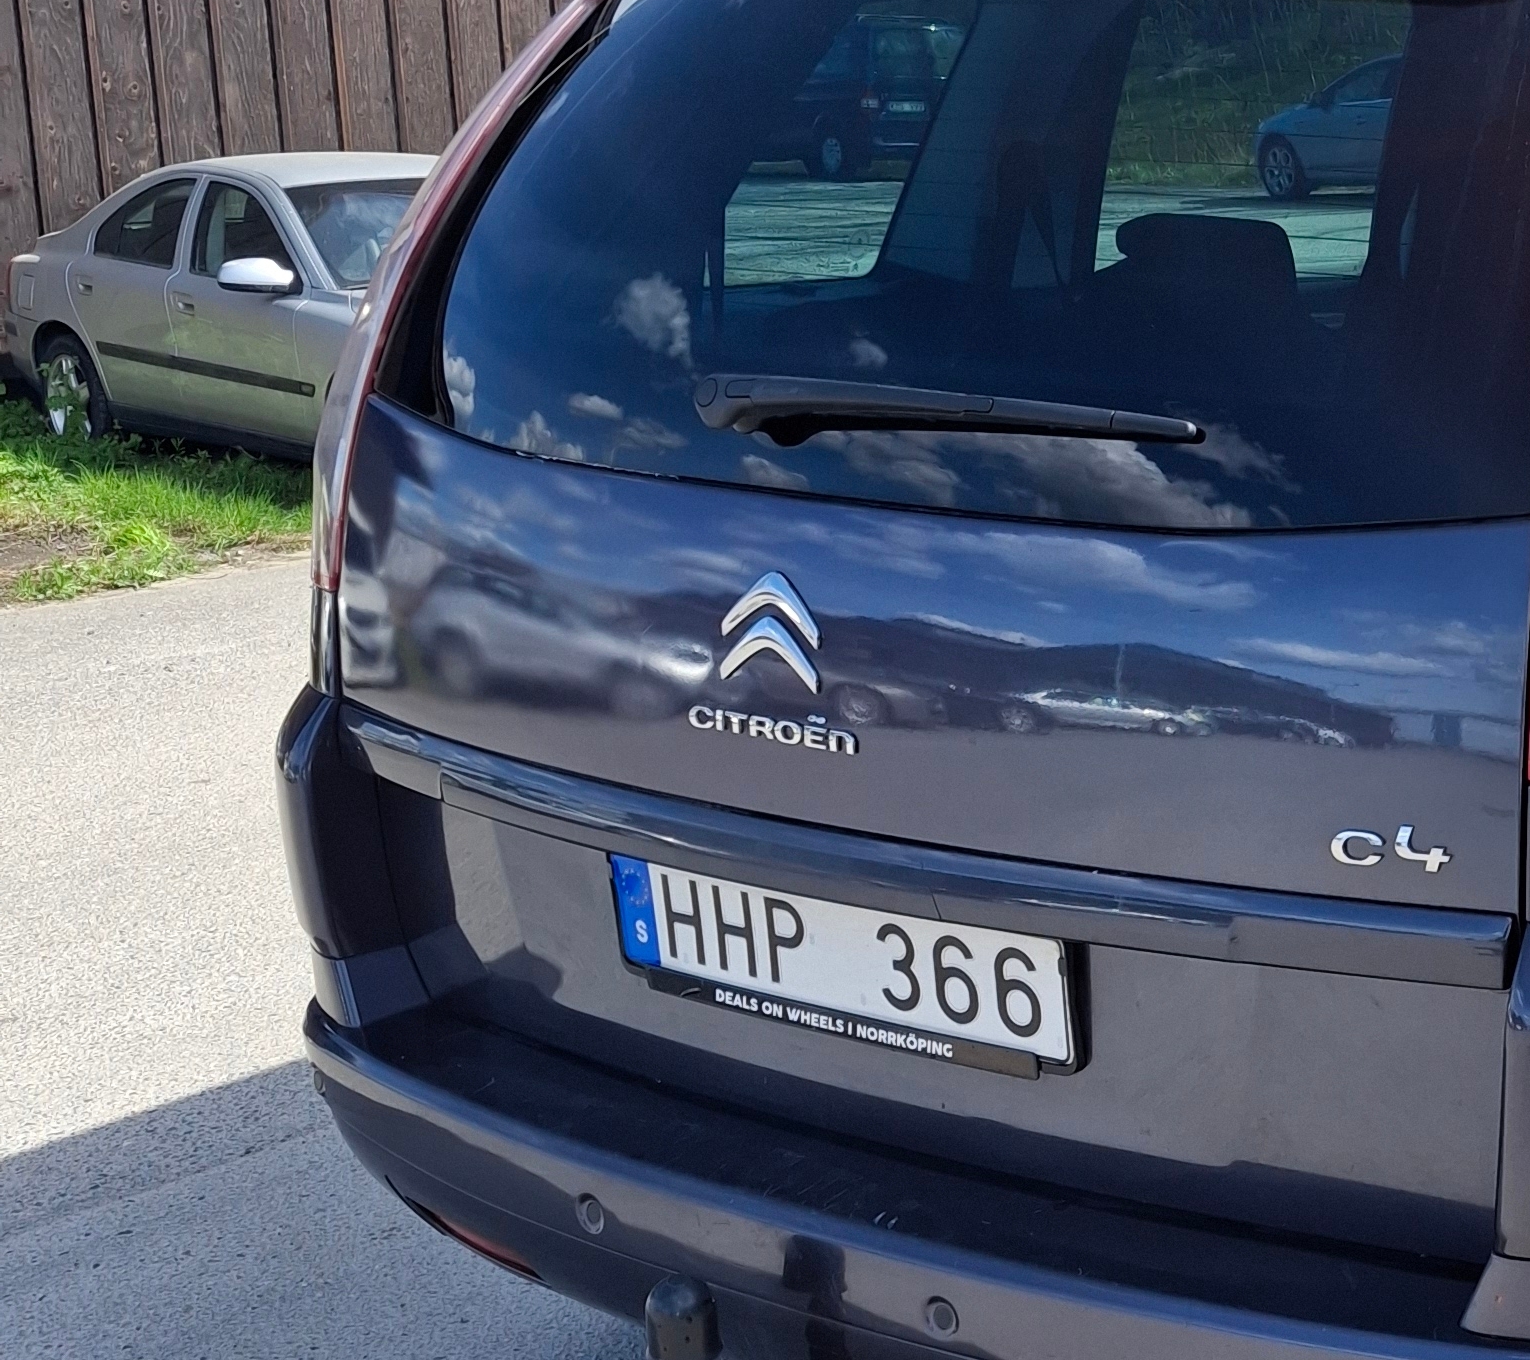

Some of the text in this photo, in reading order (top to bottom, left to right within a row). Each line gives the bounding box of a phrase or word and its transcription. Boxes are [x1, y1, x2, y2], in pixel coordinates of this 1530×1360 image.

[1330, 824, 1452, 873] C4
[634, 918, 649, 944] S
[659, 873, 1043, 1038] HHP 366
[714, 988, 954, 1058] DEALS ON WHEELS I NORRKÖPING
